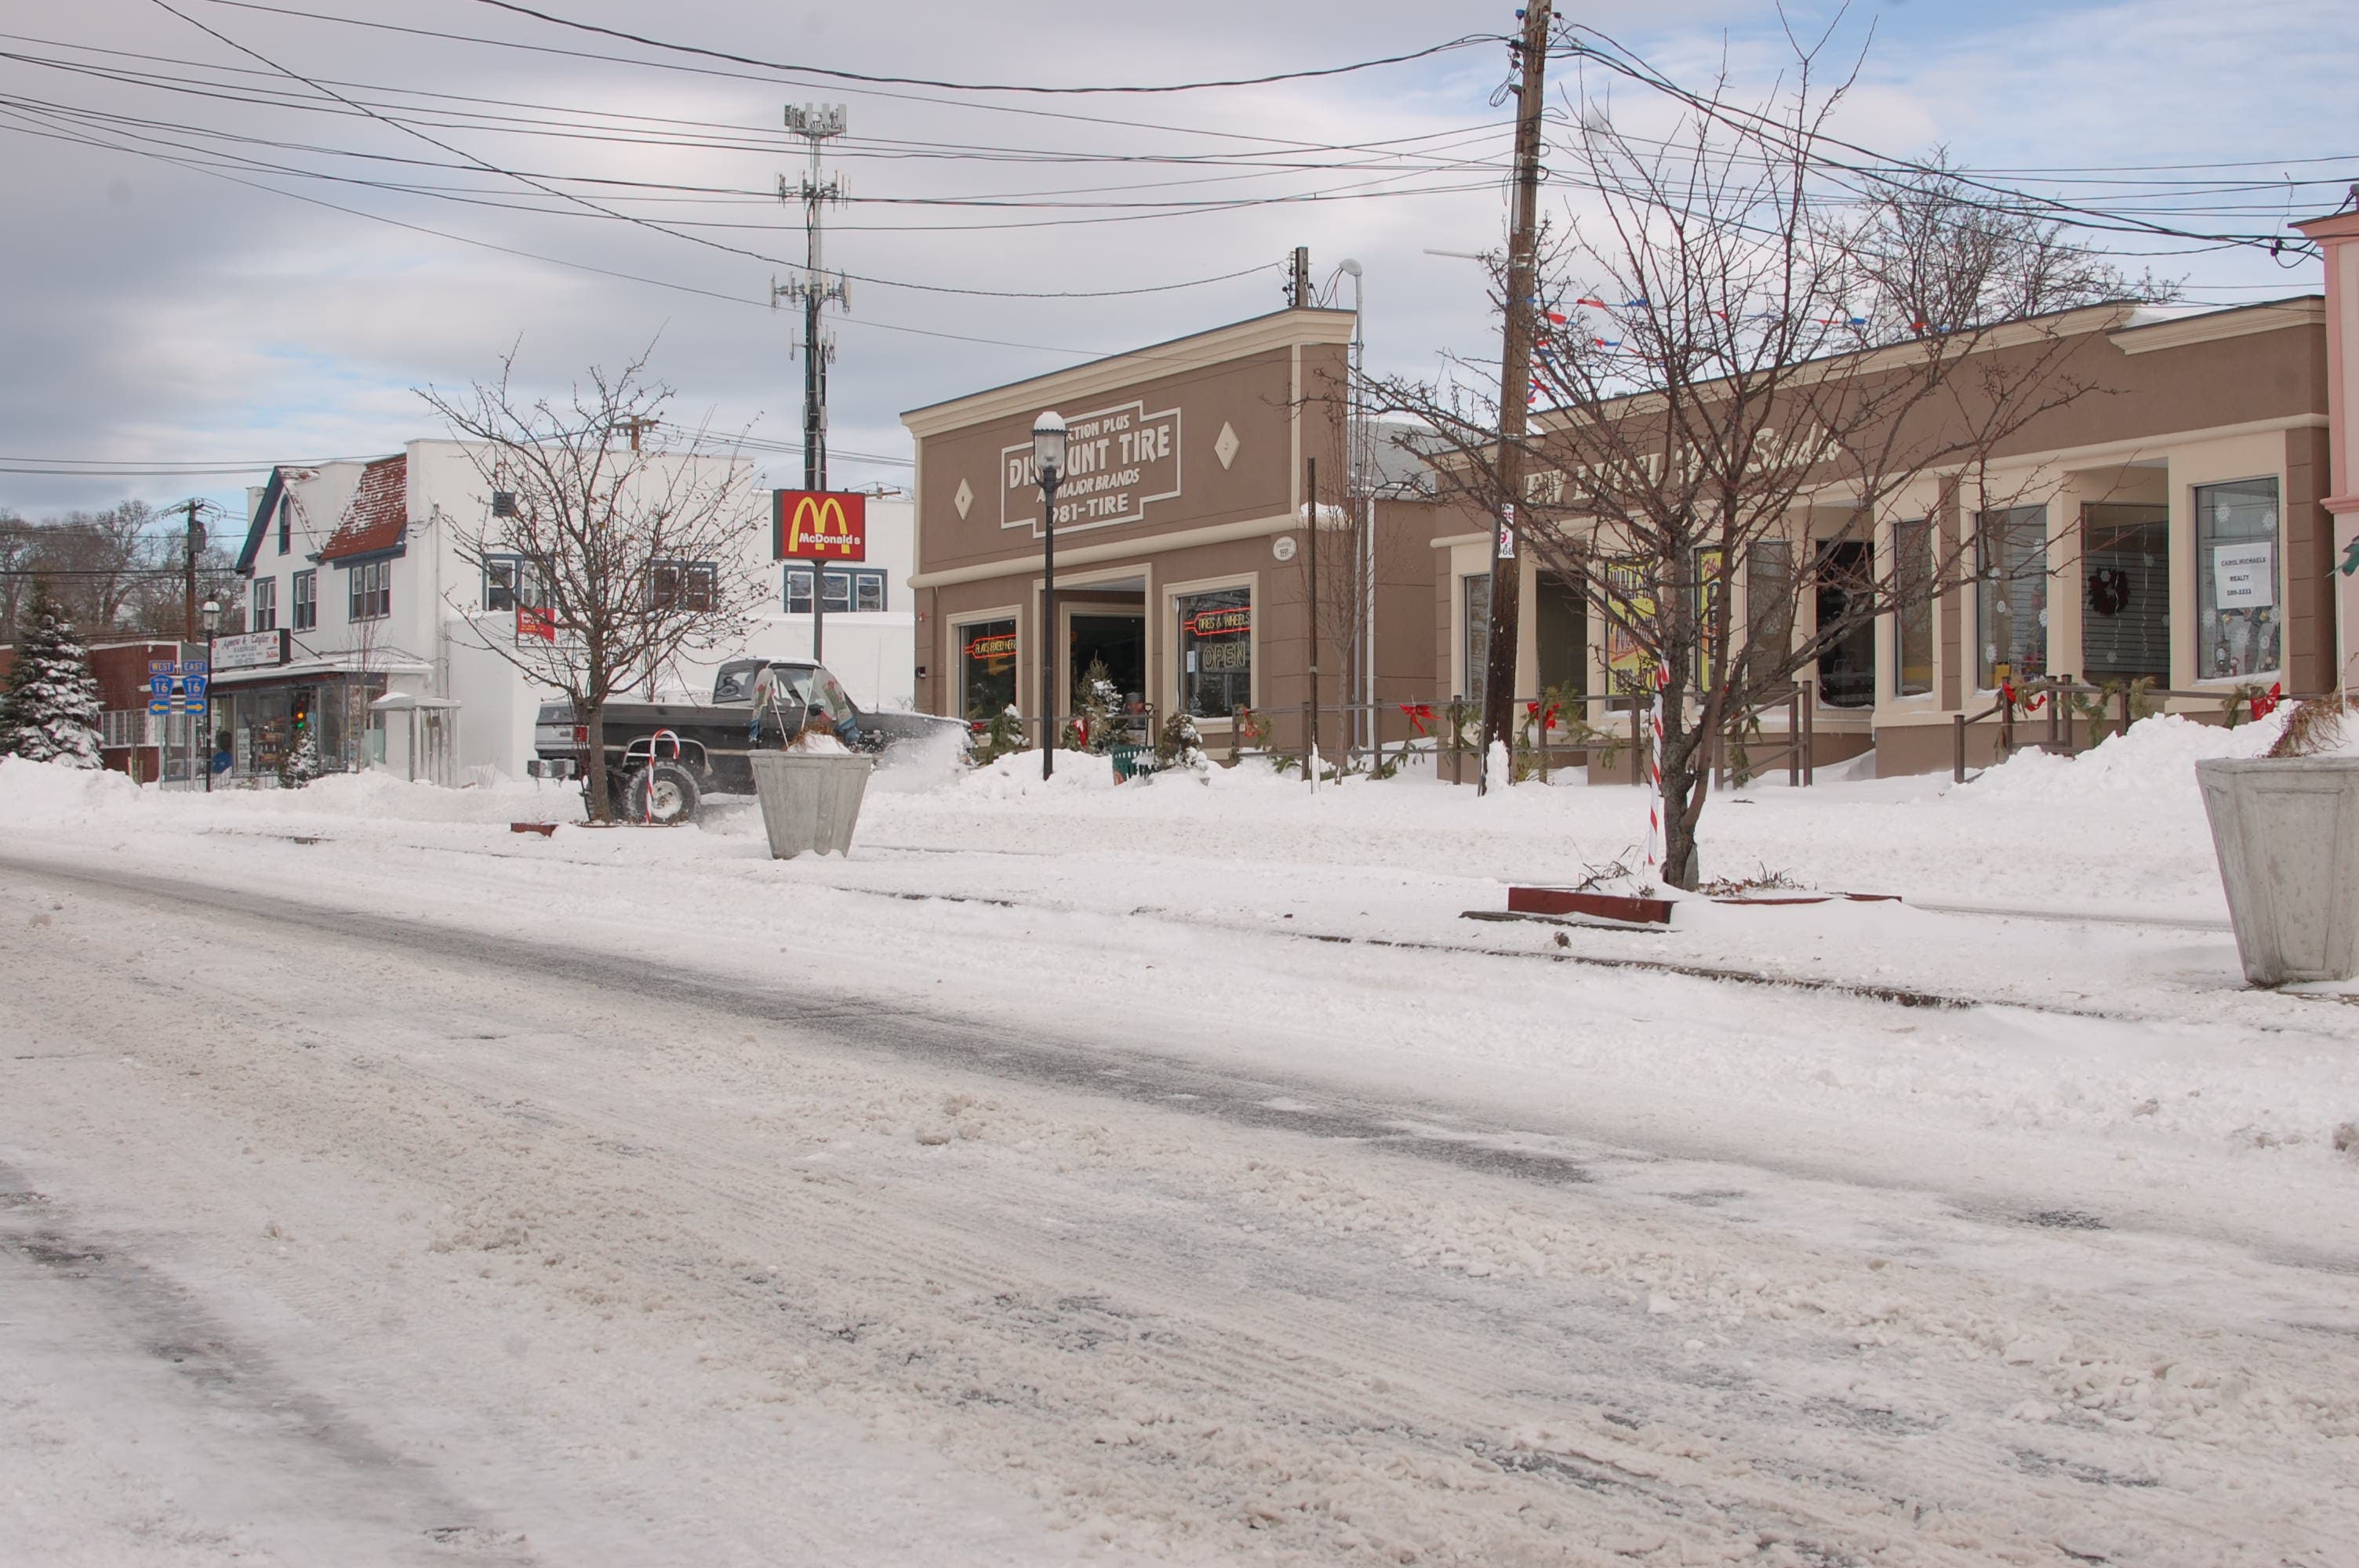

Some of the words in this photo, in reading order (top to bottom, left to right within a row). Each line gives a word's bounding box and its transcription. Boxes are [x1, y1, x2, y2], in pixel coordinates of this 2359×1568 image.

[1066, 422, 1100, 441] CTION
[1103, 415, 1129, 434] PLUS
[1010, 438, 1110, 488] DISUNT
[1119, 425, 1170, 465] TIRE
[1056, 478, 1094, 499] MAJOR
[1095, 468, 1140, 491] BRANDS
[1203, 642, 1246, 670] OPEN
[151, 662, 171, 671] WEST
[184, 662, 203, 671] EAST
[155, 682, 168, 692] 16
[188, 682, 201, 692] 16
